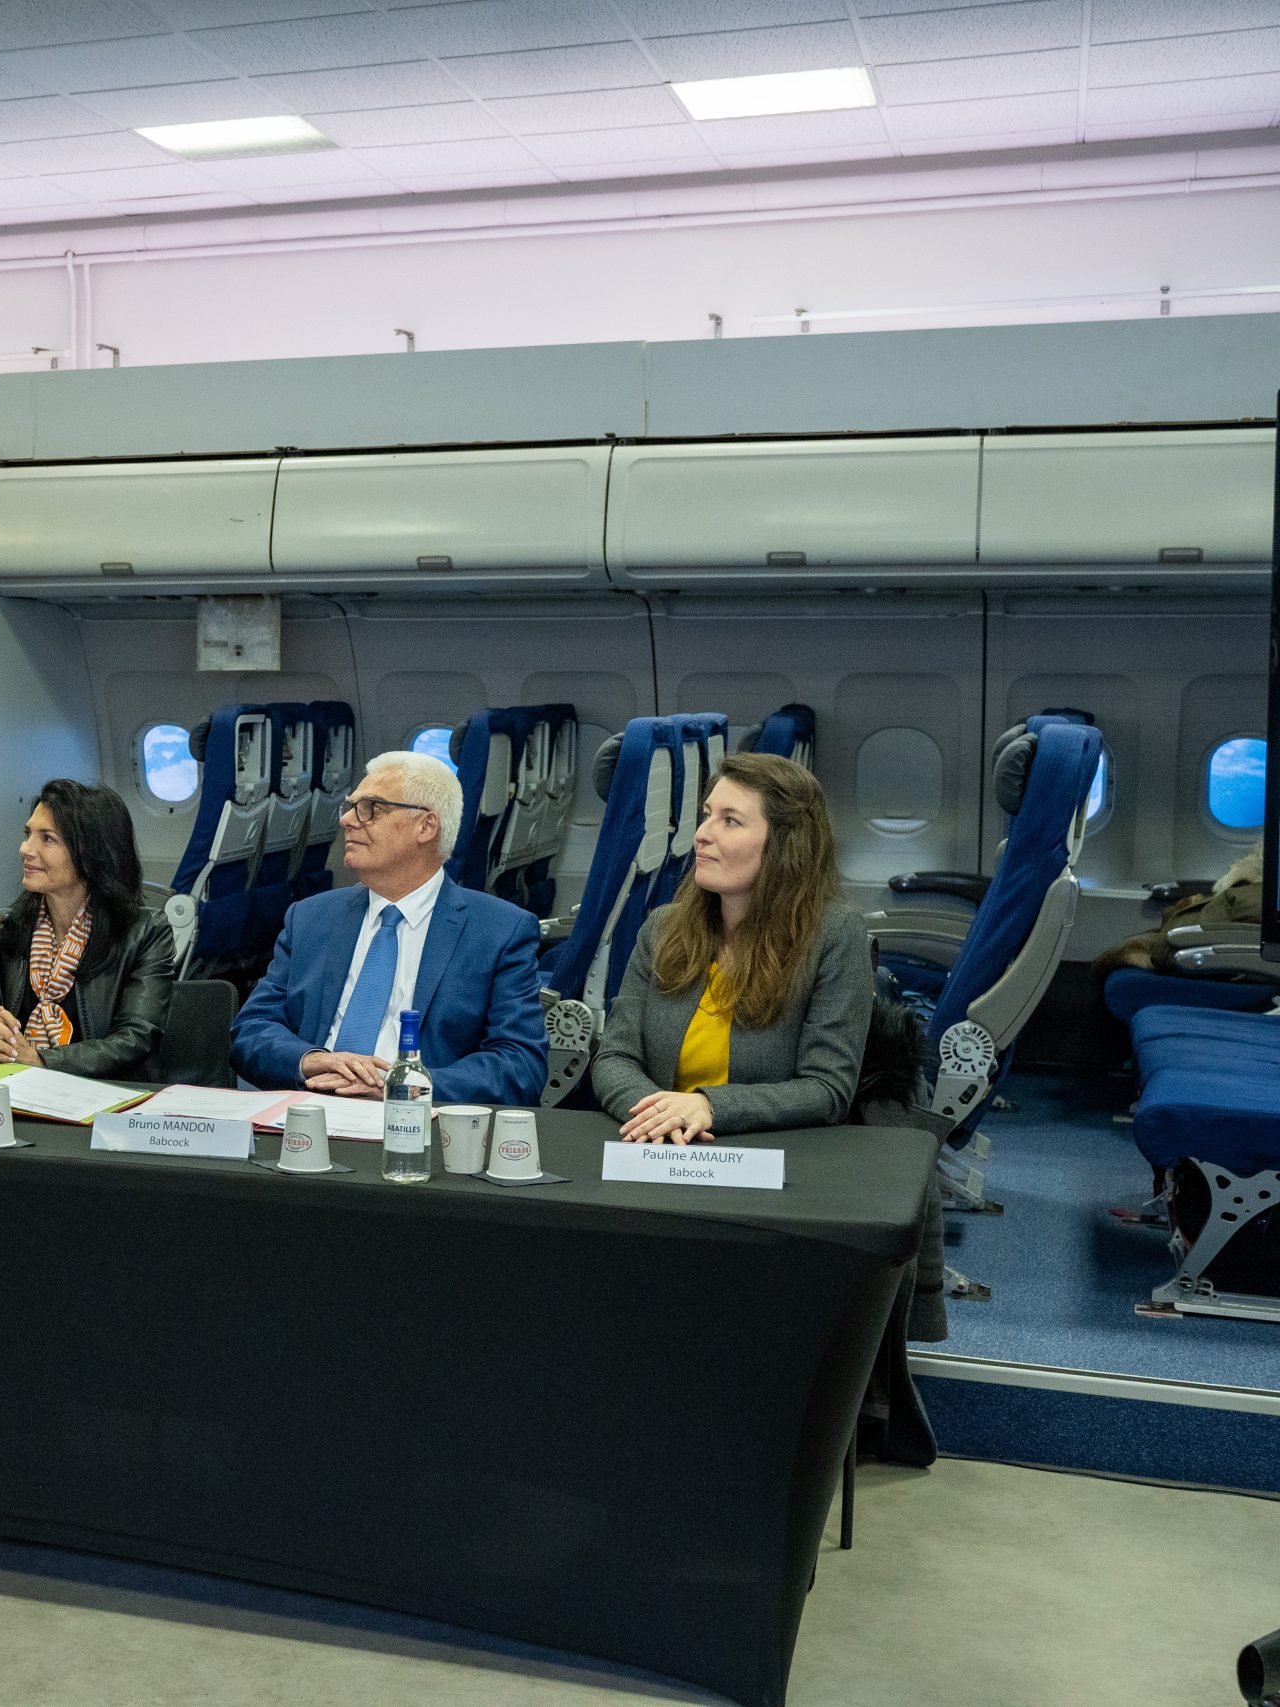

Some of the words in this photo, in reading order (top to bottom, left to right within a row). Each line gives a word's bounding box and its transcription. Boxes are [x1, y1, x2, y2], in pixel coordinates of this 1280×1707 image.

[128, 1118, 161, 1130] Bruno
[162, 1120, 215, 1133] MANDON
[387, 1124, 421, 1133] ABATILLES
[149, 1135, 190, 1147] Babcock
[642, 1148, 687, 1161] Pauline
[689, 1151, 744, 1164] AMAURY
[669, 1166, 715, 1178] Babcock
